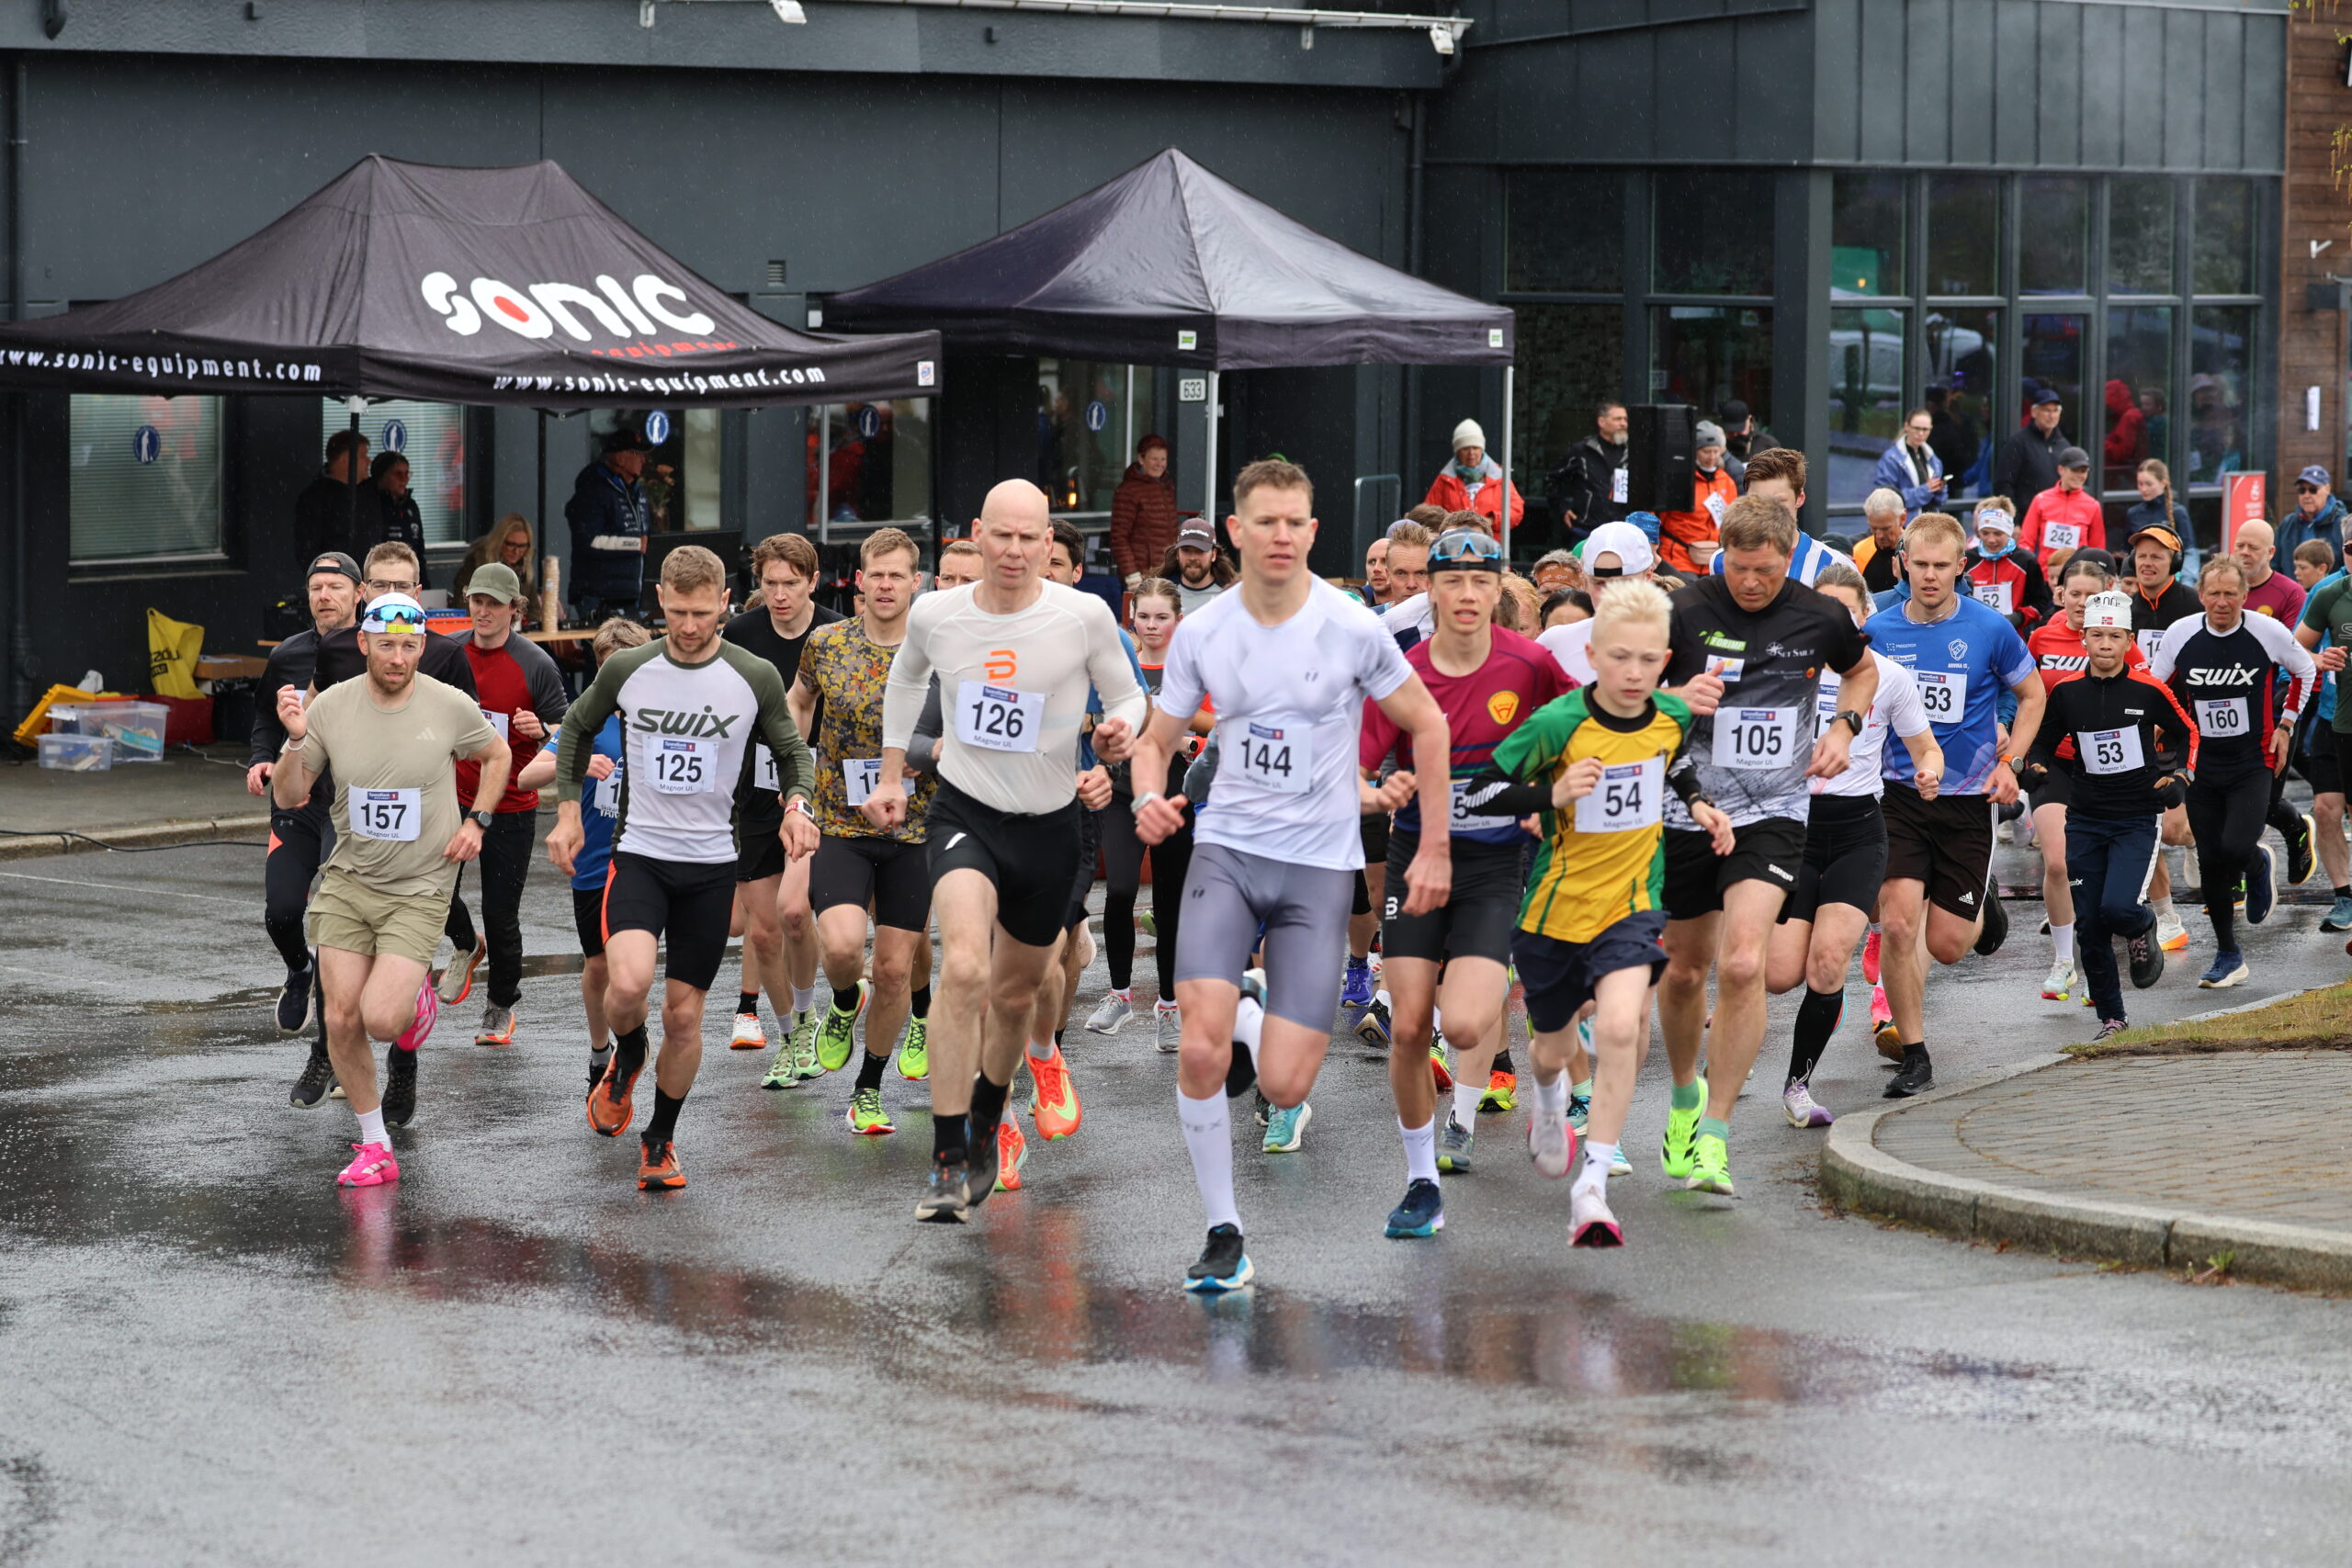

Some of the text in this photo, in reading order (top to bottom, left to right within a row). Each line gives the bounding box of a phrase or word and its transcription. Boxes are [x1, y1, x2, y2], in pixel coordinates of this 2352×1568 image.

[493, 366, 826, 396] www.sonic-equipment.com
[1184, 381, 1202, 399] 633
[2050, 529, 2074, 545] 242
[1917, 684, 1951, 712] 53
[972, 701, 1024, 739] 126
[2206, 708, 2239, 729] 160
[1731, 725, 1782, 755] 105
[2097, 741, 2124, 765] 53
[655, 753, 703, 783] 125
[1241, 738, 1293, 778] 144
[1605, 782, 1643, 818] 54
[361, 803, 407, 829] 157
[367, 829, 390, 839] Magnor
